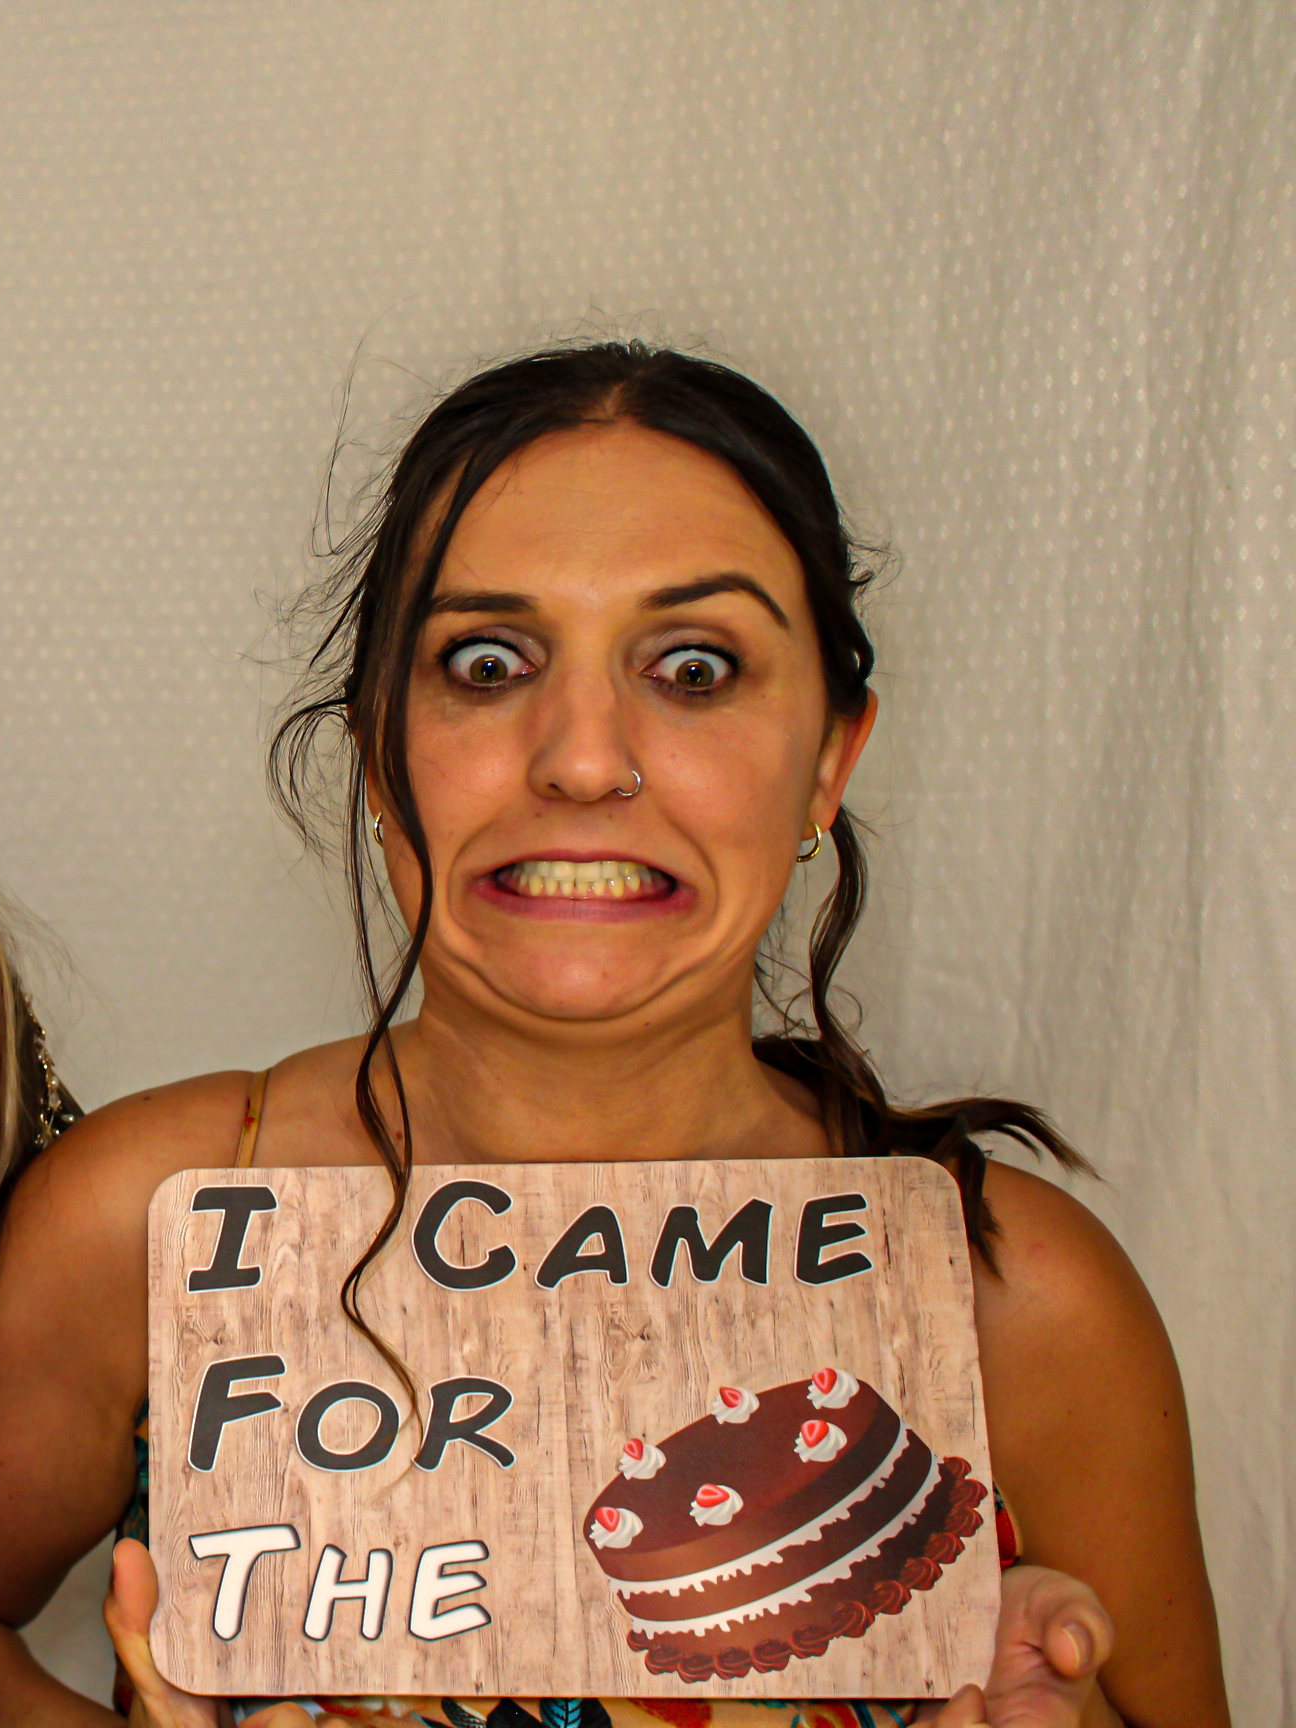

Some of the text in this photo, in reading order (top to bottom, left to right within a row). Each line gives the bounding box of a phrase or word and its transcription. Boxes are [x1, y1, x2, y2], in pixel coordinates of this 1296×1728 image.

[187, 1179, 875, 1294] I CAME
[187, 1353, 517, 1473] FOR
[189, 1522, 493, 1643] THE
